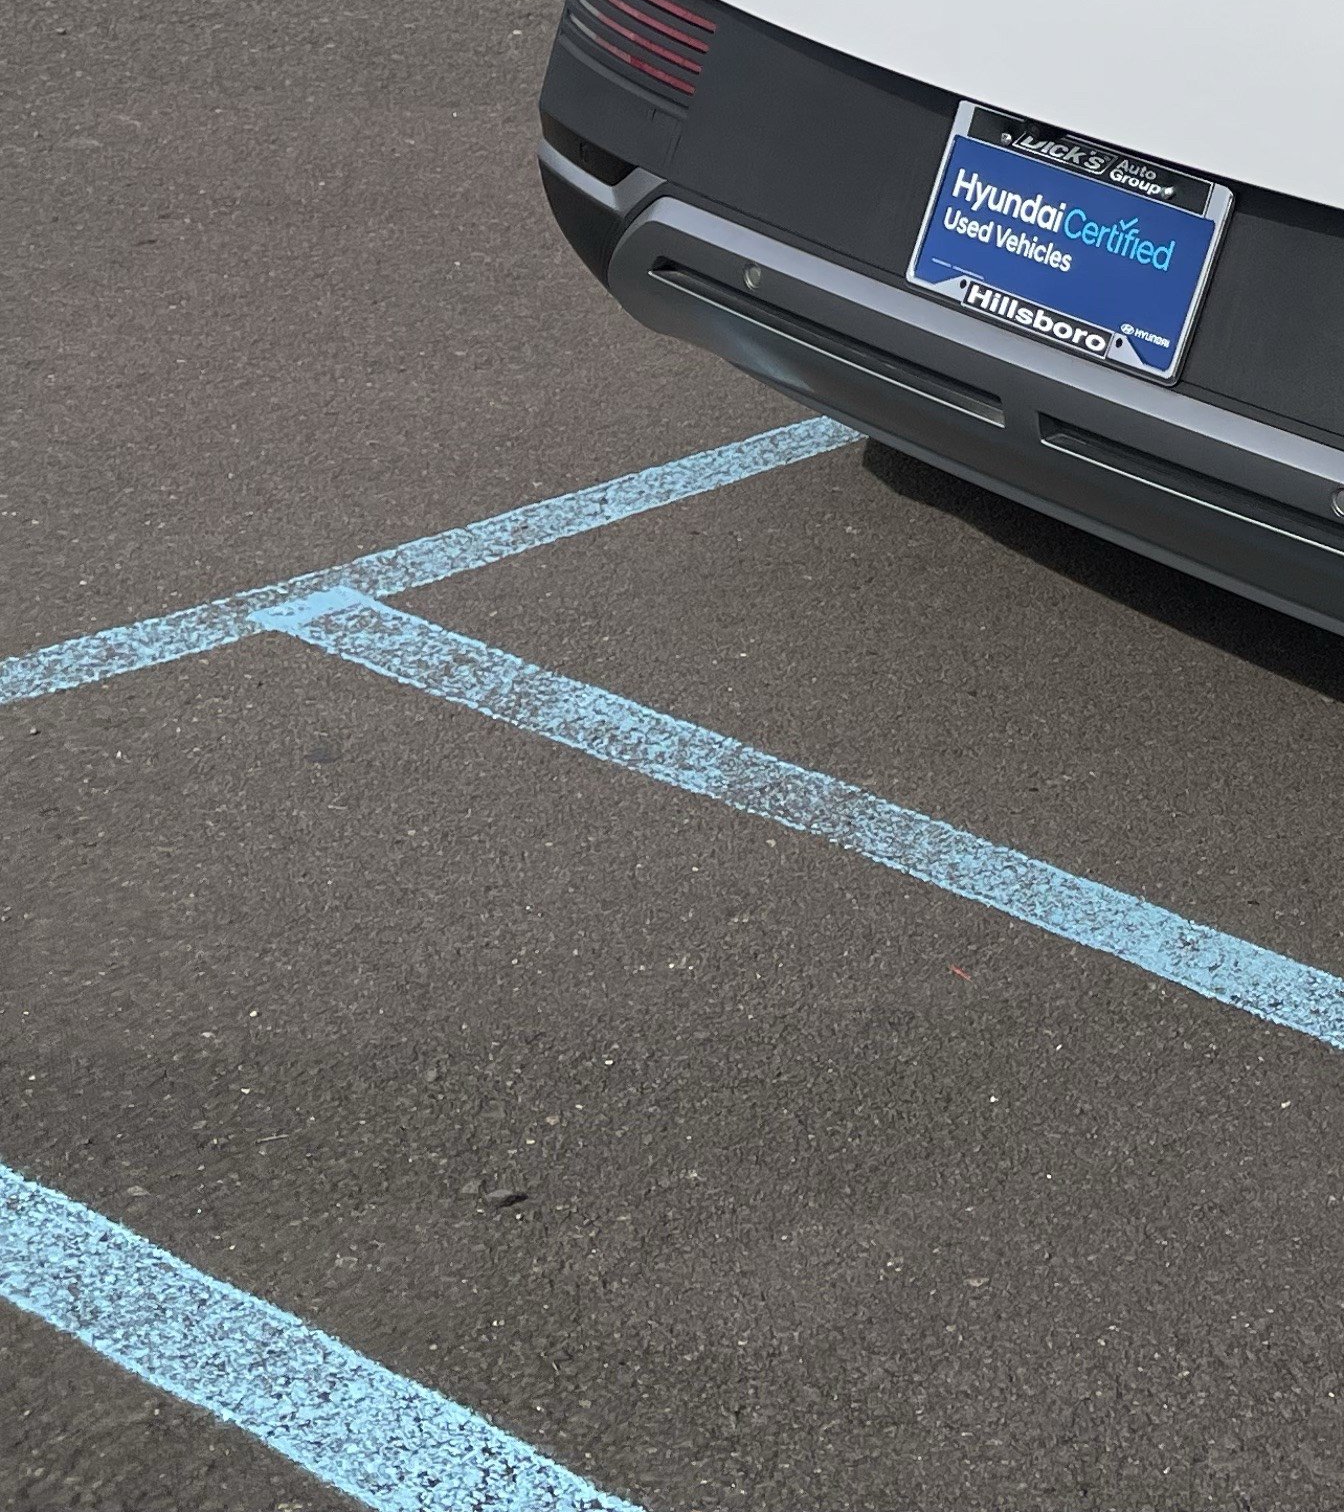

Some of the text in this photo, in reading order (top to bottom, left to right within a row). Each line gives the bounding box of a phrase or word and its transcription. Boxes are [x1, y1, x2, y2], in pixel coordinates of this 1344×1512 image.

[1109, 169, 1161, 196] Group
[1116, 159, 1157, 181] Auto
[943, 207, 1073, 272] Used Vehicles
[966, 284, 1107, 353] Hillsboro
[1134, 328, 1171, 349] HYUNDAI
